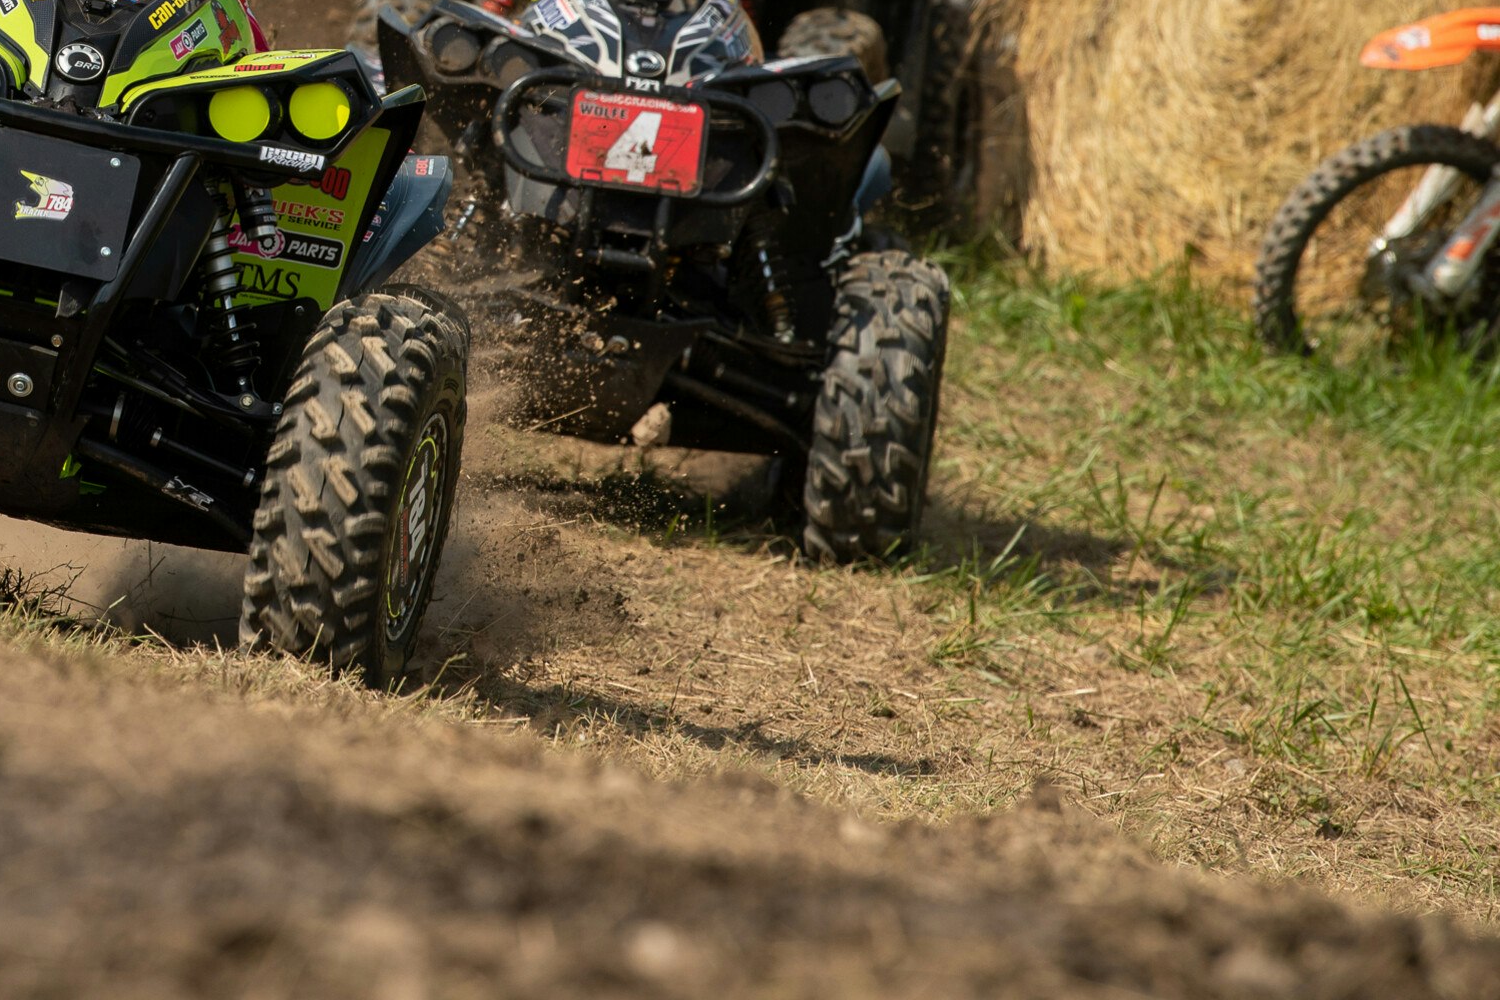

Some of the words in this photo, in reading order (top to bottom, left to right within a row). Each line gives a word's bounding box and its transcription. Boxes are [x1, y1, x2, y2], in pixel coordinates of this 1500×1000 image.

[74, 60, 101, 71] BRP
[579, 101, 629, 120] WOLFE
[603, 110, 663, 183] 4
[415, 158, 429, 176] GBC
[46, 194, 73, 212] 784
[272, 200, 346, 225] UCK'S
[287, 215, 342, 233] SERVICE
[287, 240, 339, 262] PARTS
[408, 462, 426, 563] 784
